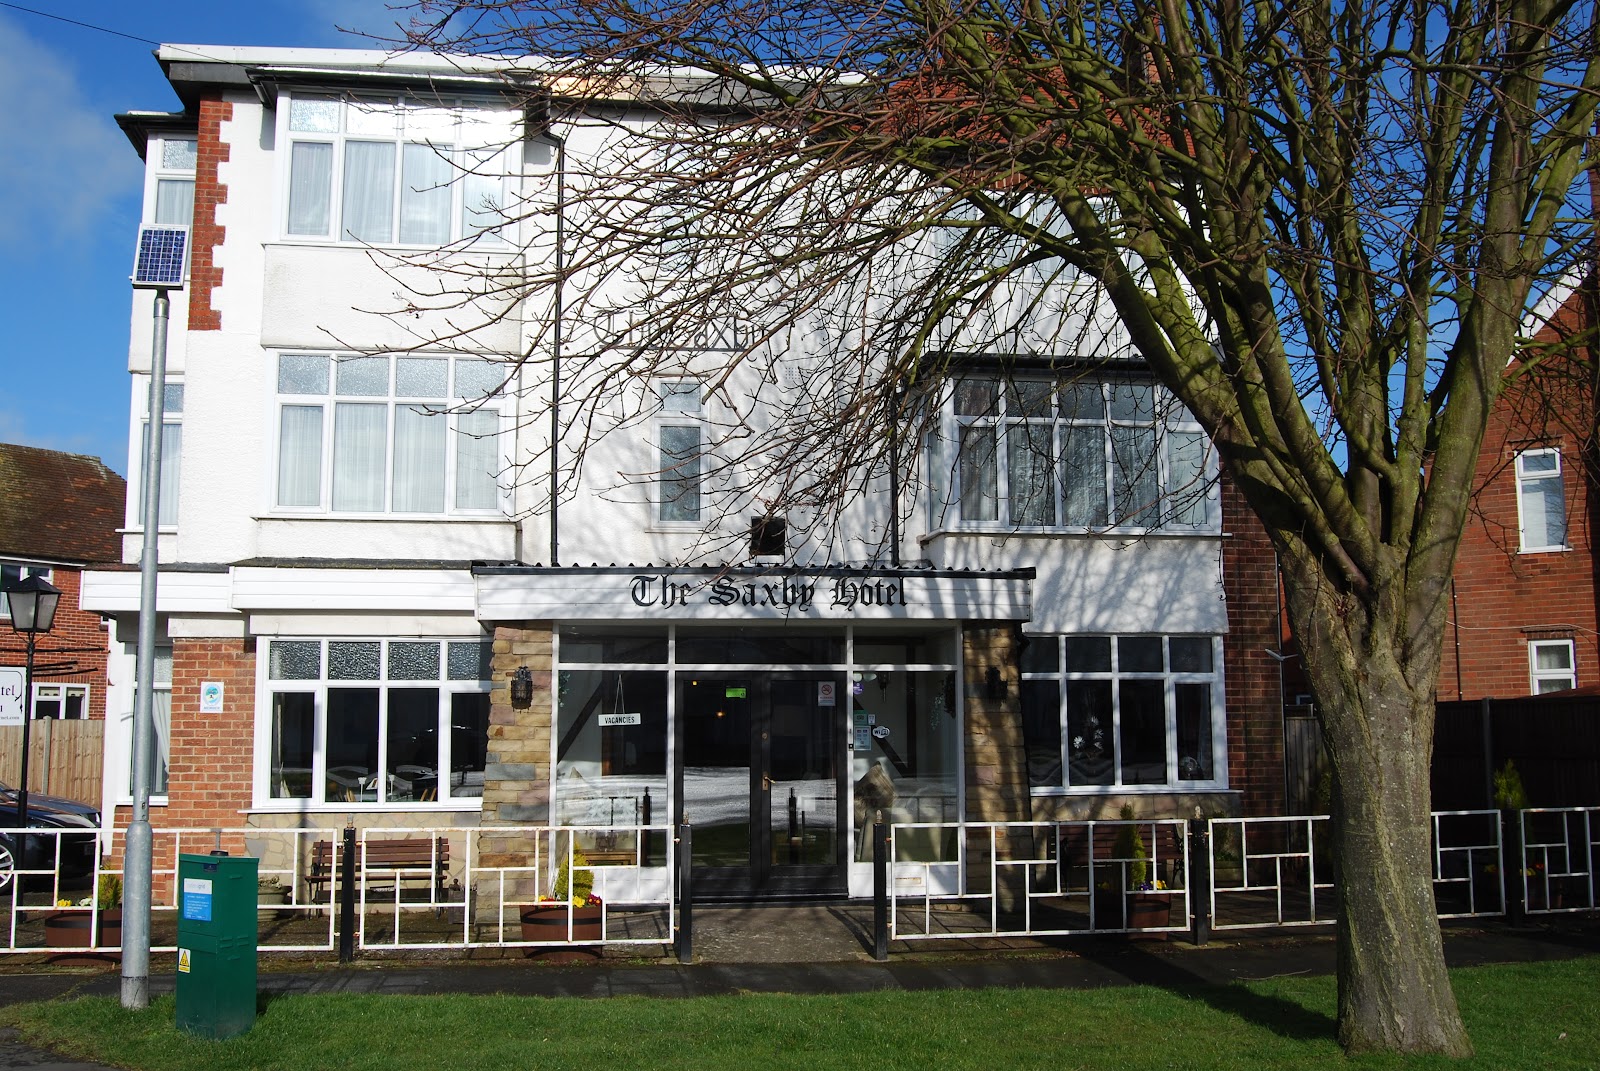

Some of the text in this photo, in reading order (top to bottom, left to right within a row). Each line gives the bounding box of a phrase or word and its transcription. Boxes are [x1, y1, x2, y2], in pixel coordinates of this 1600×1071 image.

[629, 575, 908, 611] The Saxby Hotel
[605, 716, 635, 724] VACANCIES
